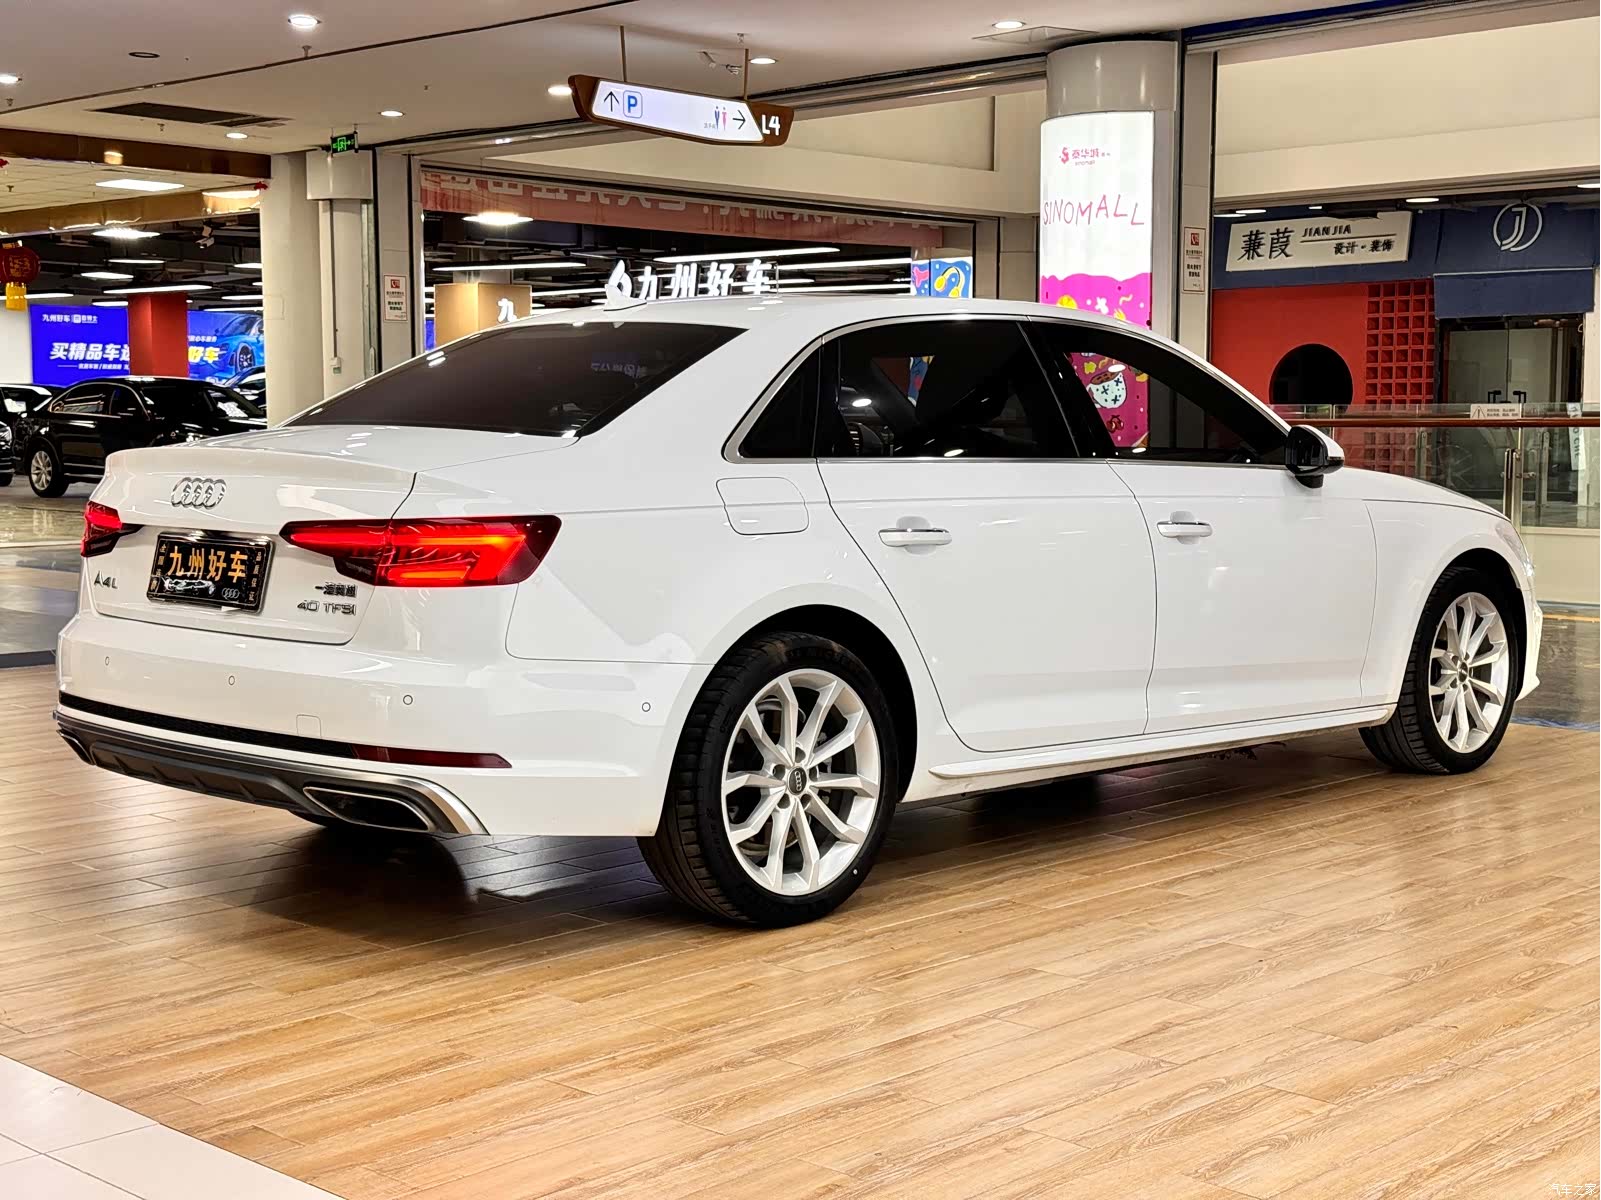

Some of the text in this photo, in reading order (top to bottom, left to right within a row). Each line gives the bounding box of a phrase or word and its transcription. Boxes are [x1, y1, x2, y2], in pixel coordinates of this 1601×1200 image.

[626, 95, 638, 113] P
[761, 114, 781, 136] L4
[1043, 194, 1145, 226] SINOMALL
[637, 258, 772, 300] 九州好车
[42, 314, 71, 323] 九州好车
[167, 545, 248, 583] 九州好车
[94, 569, 118, 590] A4L
[297, 600, 356, 616] 40 TFSI
